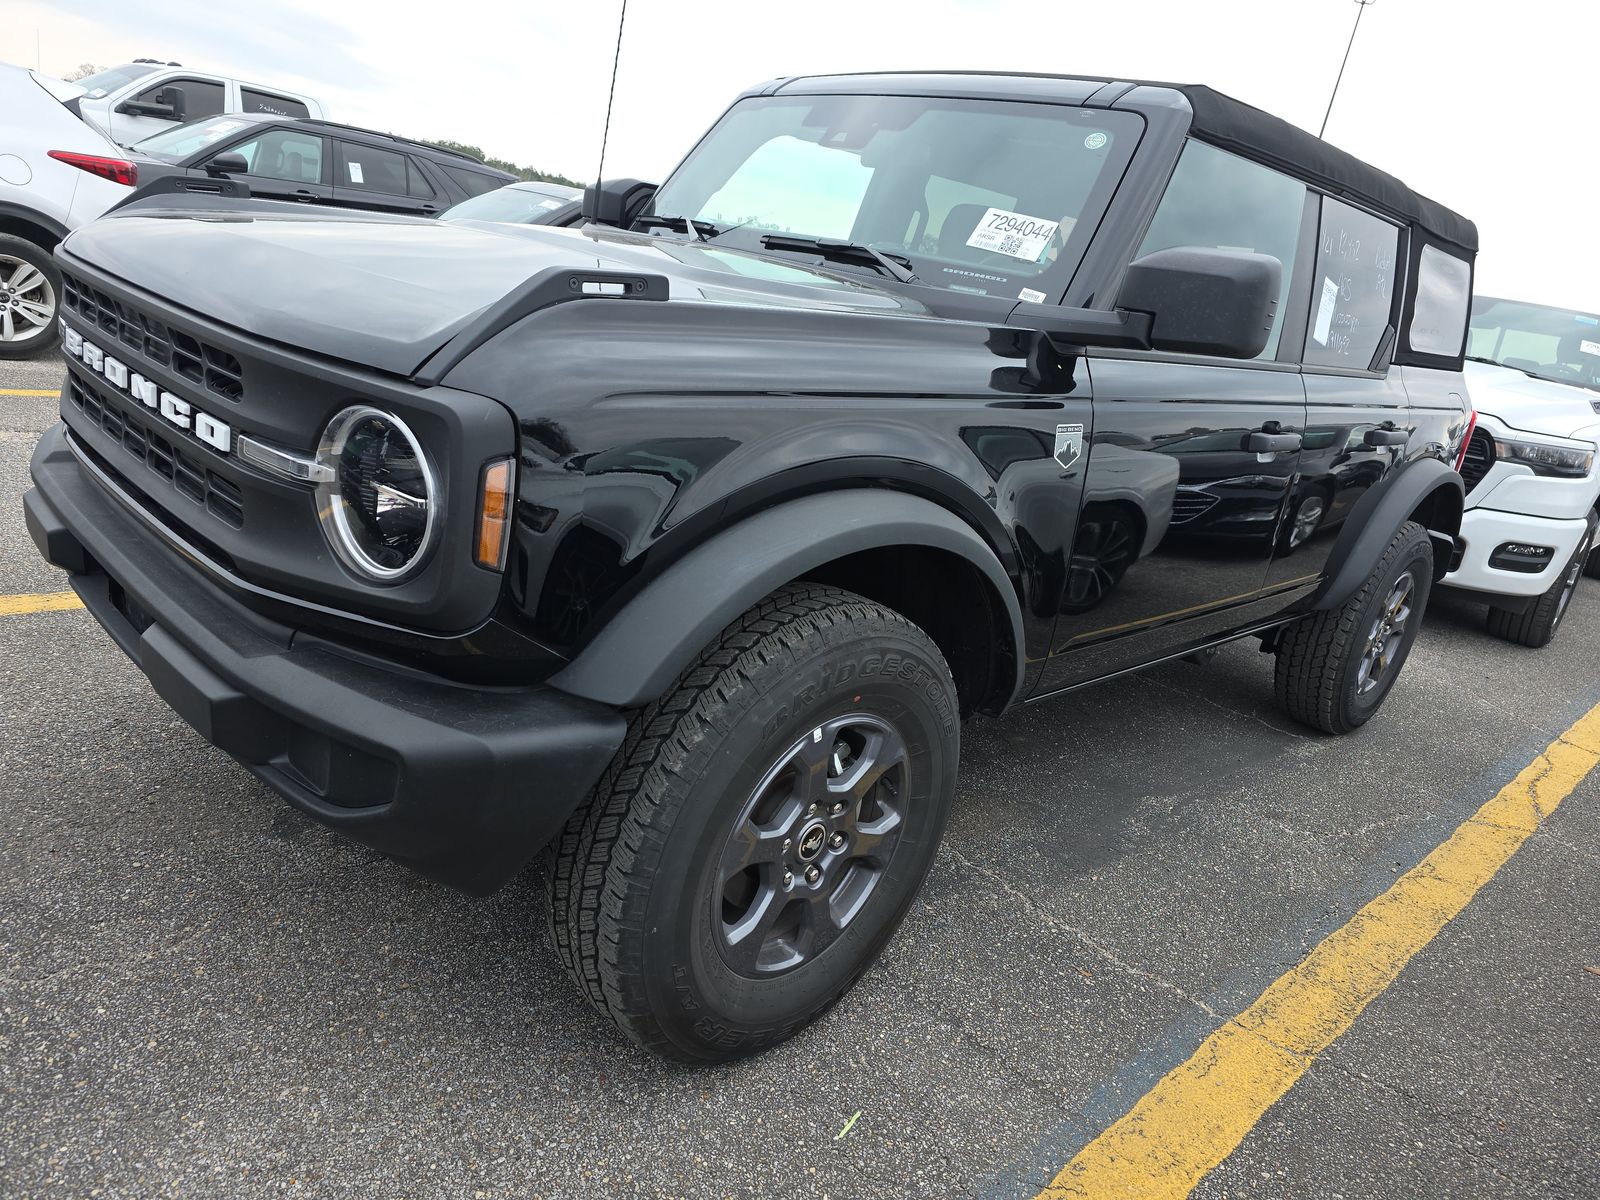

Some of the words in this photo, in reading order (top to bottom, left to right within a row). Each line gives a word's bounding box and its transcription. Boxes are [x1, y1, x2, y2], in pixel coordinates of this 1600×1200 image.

[987, 213, 1054, 241] 7294044
[65, 325, 231, 453] BRONCO
[762, 653, 956, 743] BRIDGESTONE
